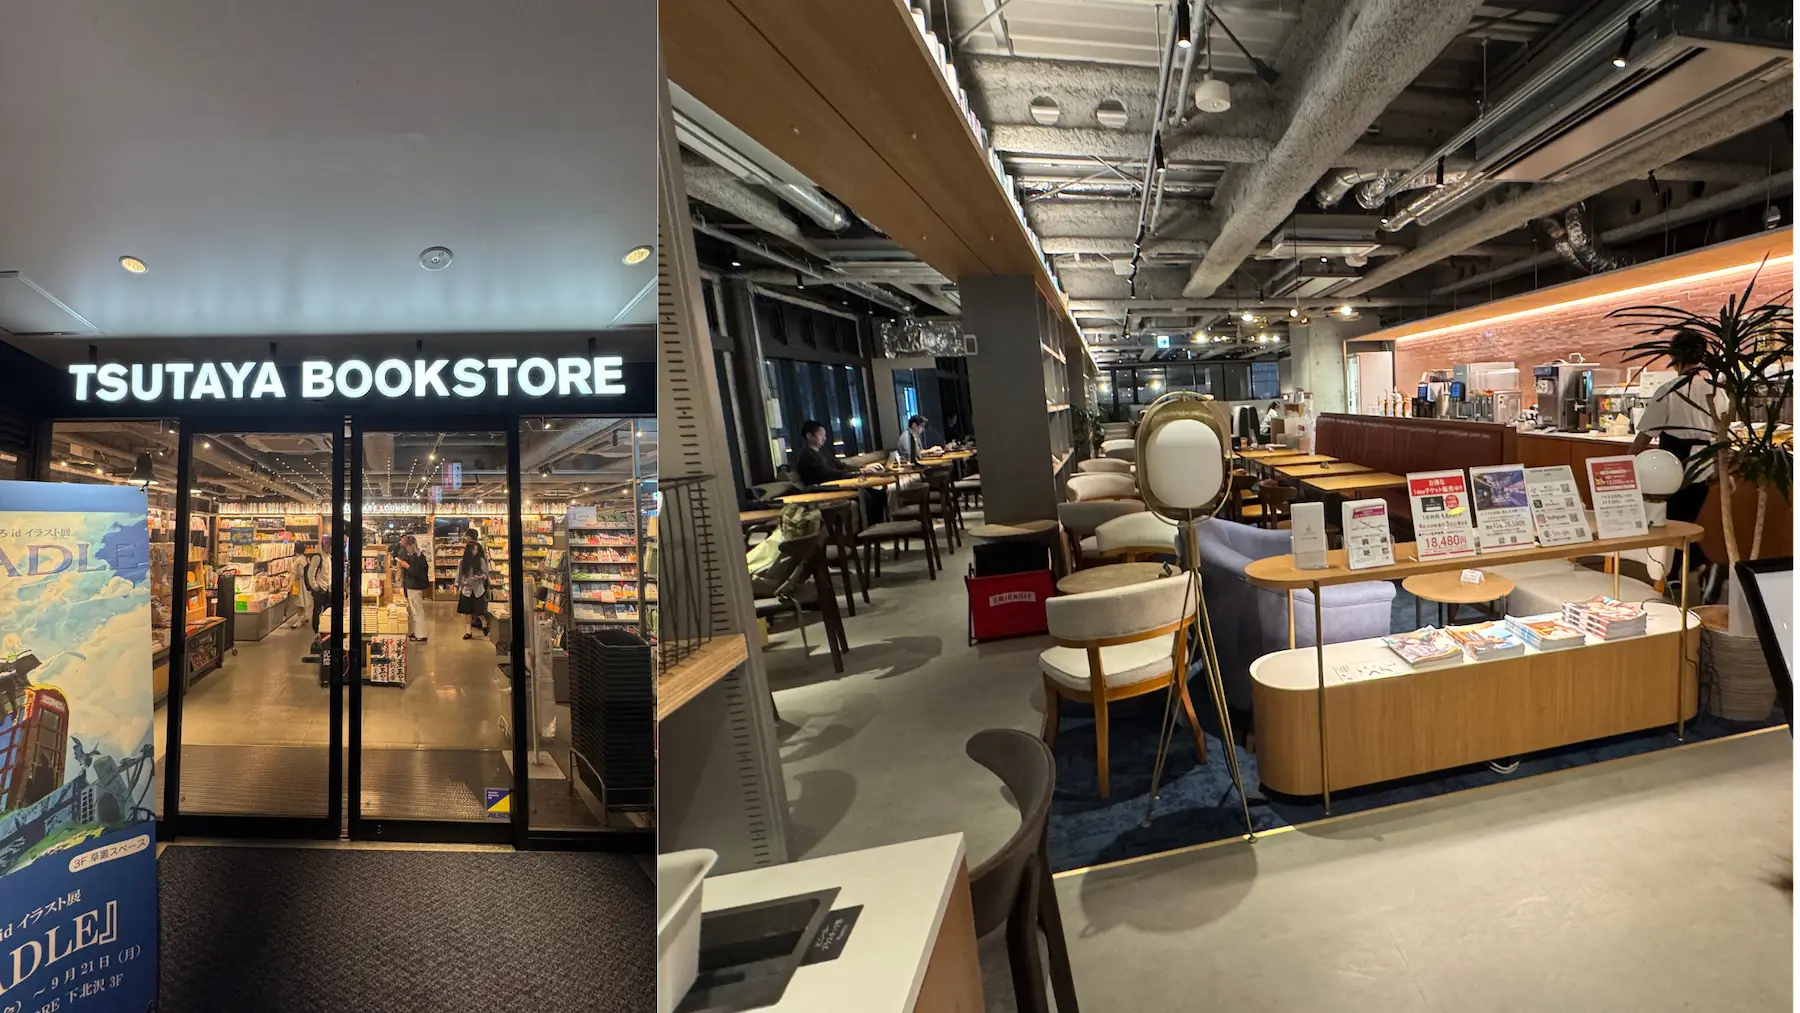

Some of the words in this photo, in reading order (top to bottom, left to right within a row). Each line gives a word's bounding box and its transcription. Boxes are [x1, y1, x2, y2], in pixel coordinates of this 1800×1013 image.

[68, 360, 287, 402] TSUTAYA
[301, 355, 627, 398] BOOKSTORE
[11, 528, 21, 537] id
[24, 528, 71, 538] イラスト展
[1425, 535, 1467, 549] 18,480円
[73, 855, 88, 869] 3F
[17, 889, 82, 929] イラスト展
[65, 979, 106, 1003] 下北沢
[109, 973, 124, 988] 3F
